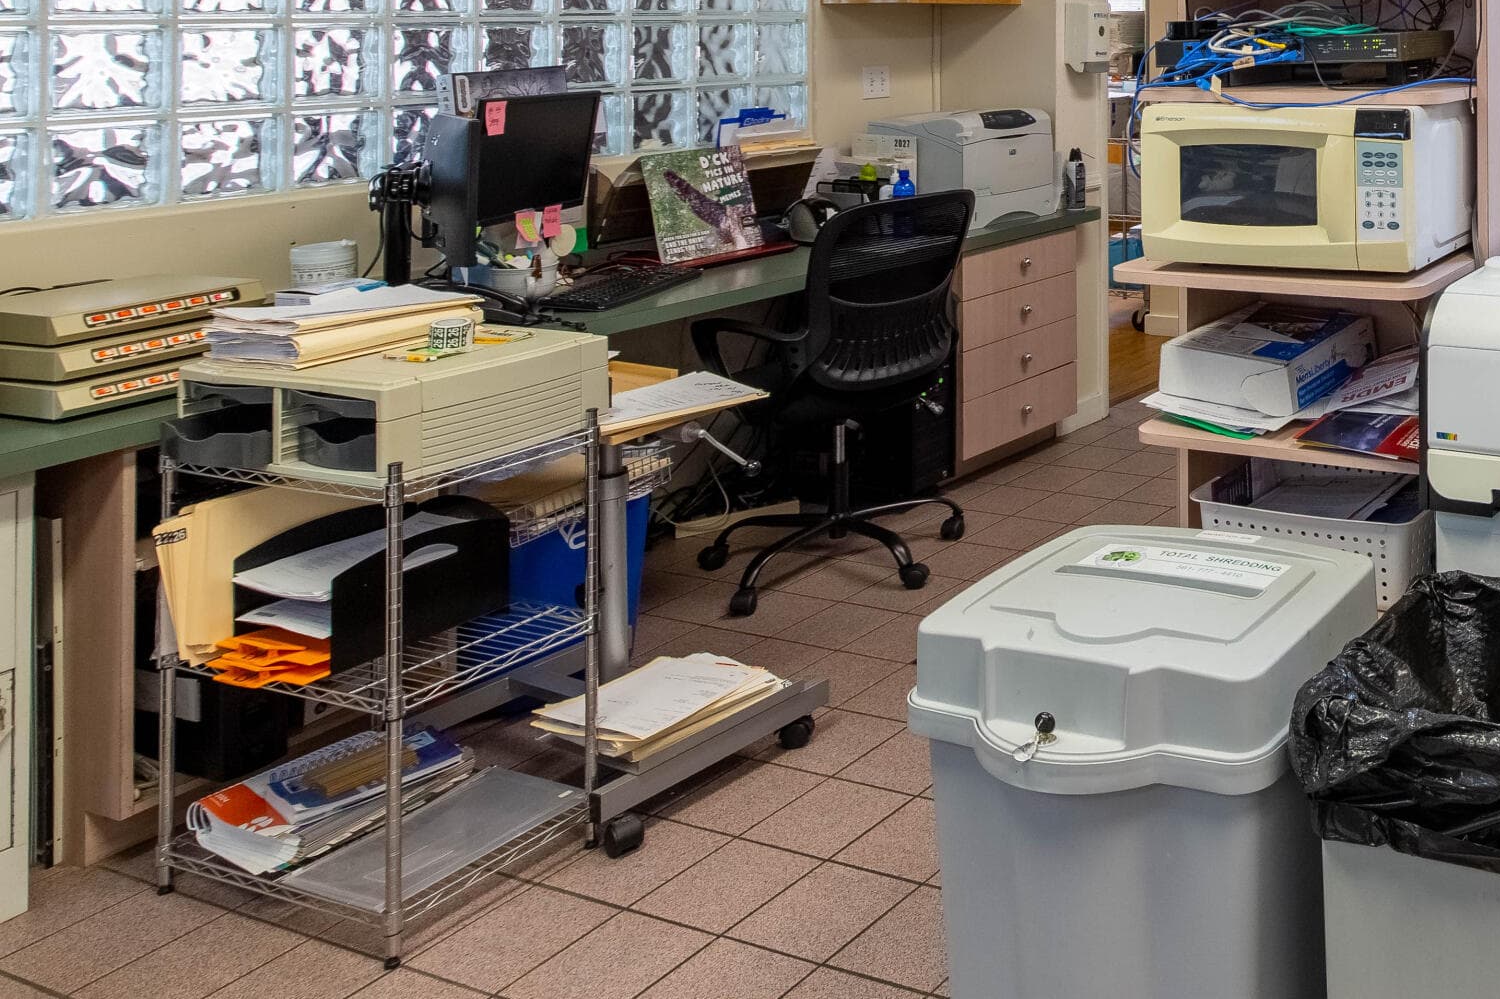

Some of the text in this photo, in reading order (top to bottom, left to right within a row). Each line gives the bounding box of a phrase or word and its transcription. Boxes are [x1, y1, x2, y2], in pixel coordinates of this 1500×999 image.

[702, 172, 744, 193] NATURE
[1160, 550, 1282, 572] TOTAL SHREDDING
